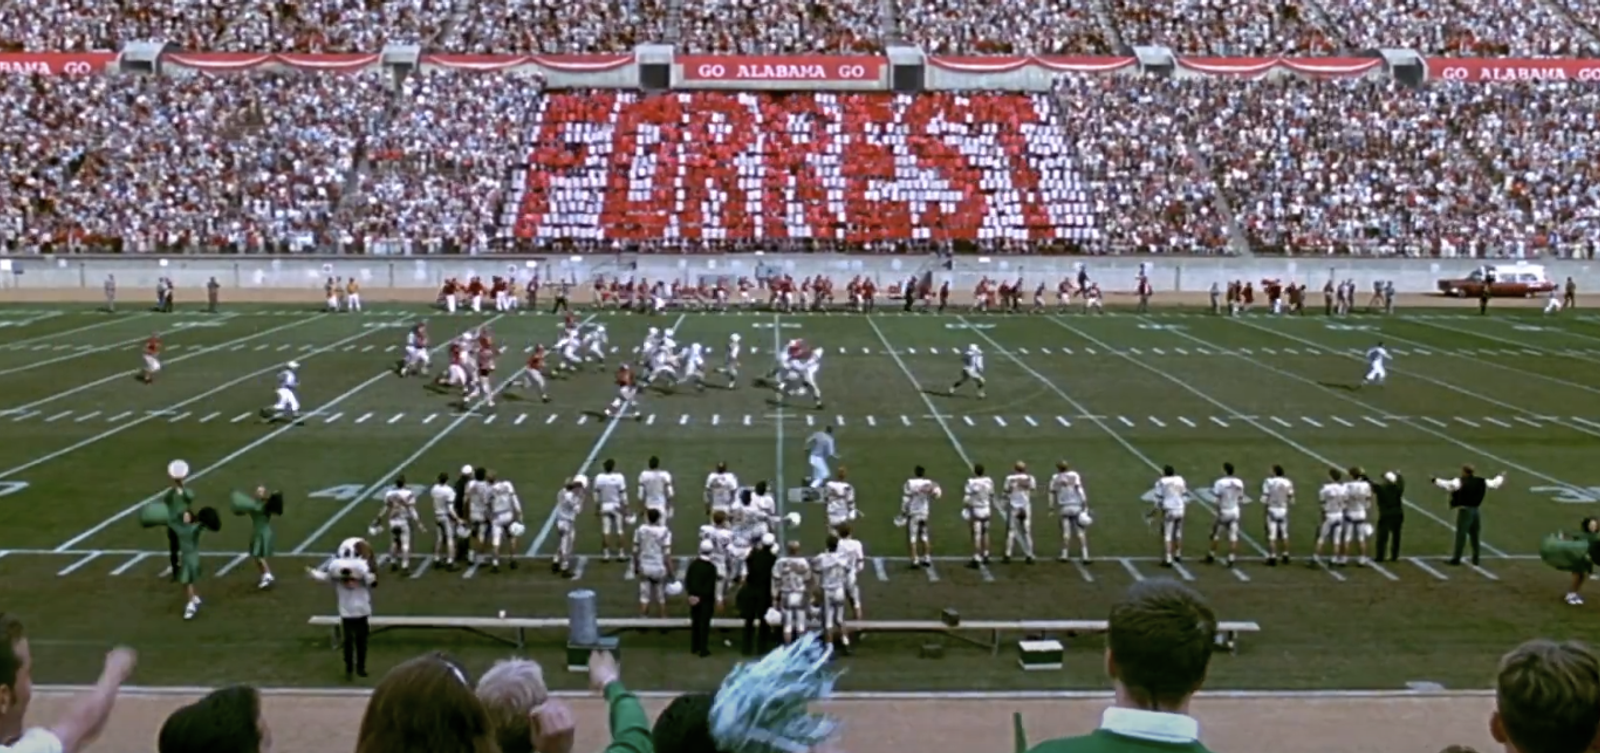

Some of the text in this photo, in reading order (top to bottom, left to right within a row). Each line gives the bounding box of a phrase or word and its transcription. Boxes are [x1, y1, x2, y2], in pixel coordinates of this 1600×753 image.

[64, 61, 91, 74] GO
[698, 64, 865, 79] GO ALABAMA GO
[1442, 67, 1600, 80] GO ALABAMA GO
[514, 92, 1056, 240] FORREST
